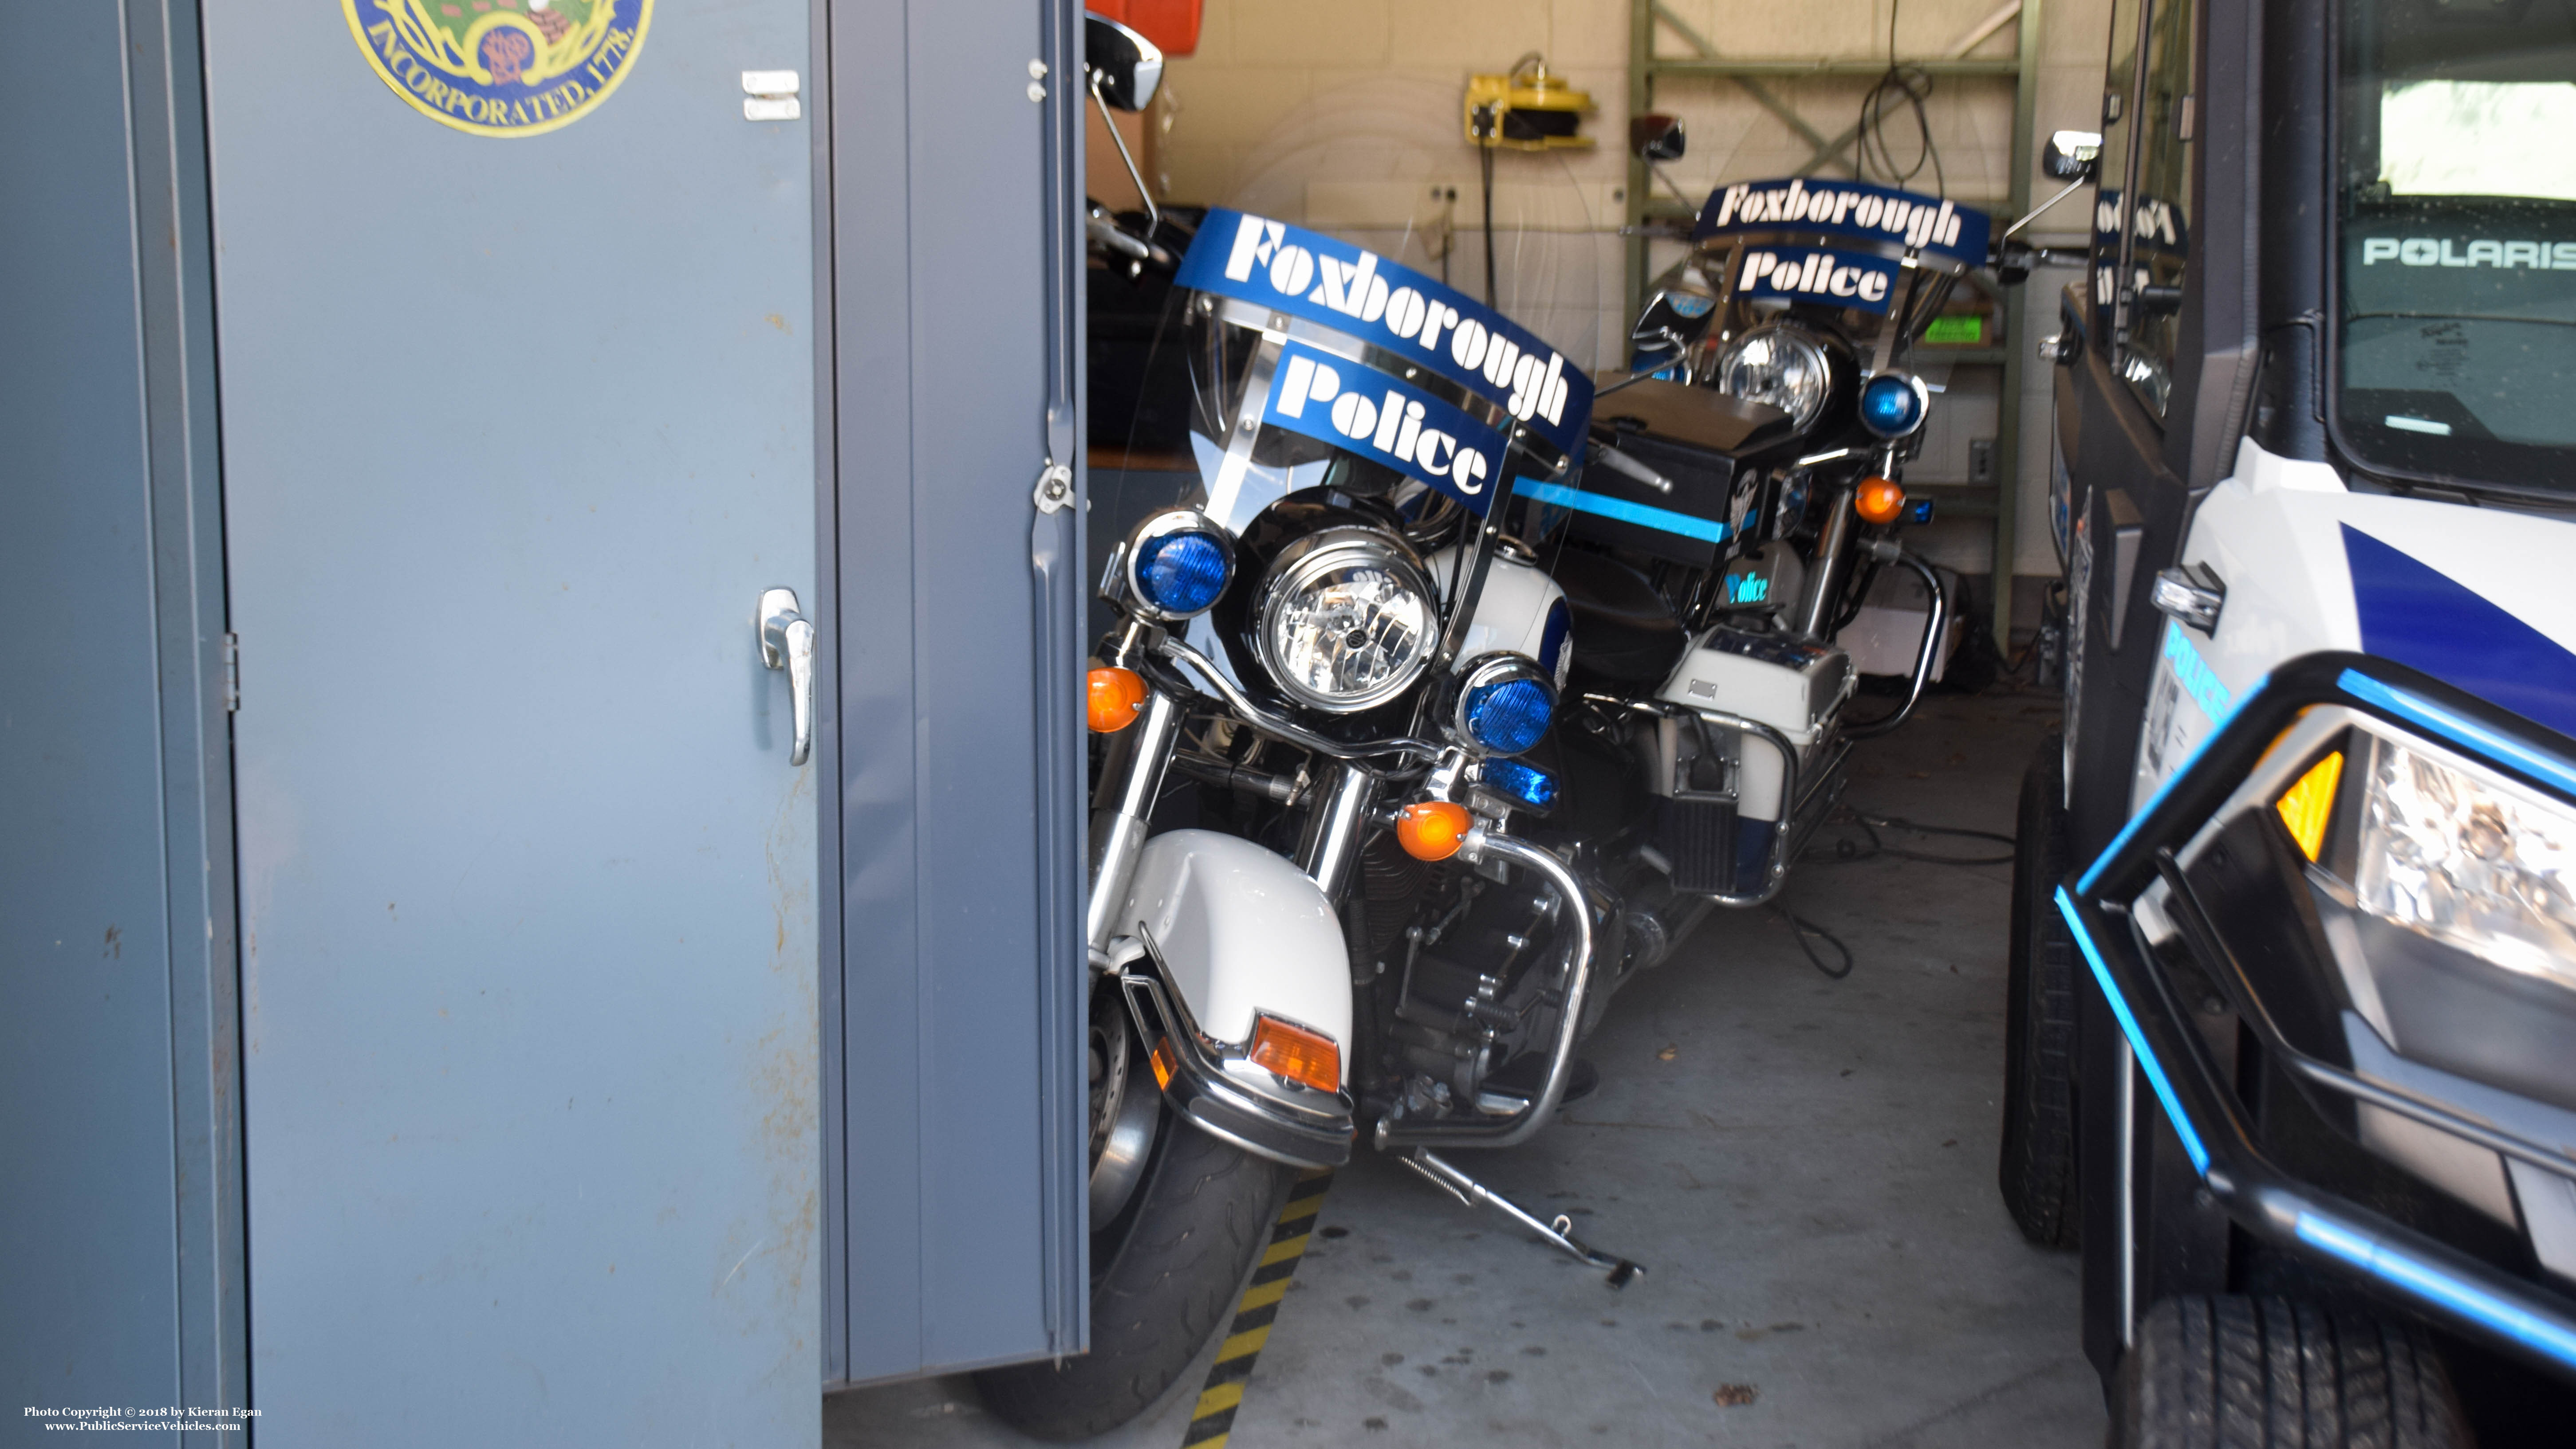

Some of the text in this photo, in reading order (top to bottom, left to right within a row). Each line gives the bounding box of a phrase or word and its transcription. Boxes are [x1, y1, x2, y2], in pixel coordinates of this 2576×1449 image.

[368, 20, 594, 126] INCORPORATED,
[1717, 178, 1961, 248] Foxborough
[2363, 238, 2576, 269] POLARIS
[1224, 213, 1568, 427] Foxborough
[1739, 252, 1888, 302] Police
[1276, 354, 1487, 495] Police
